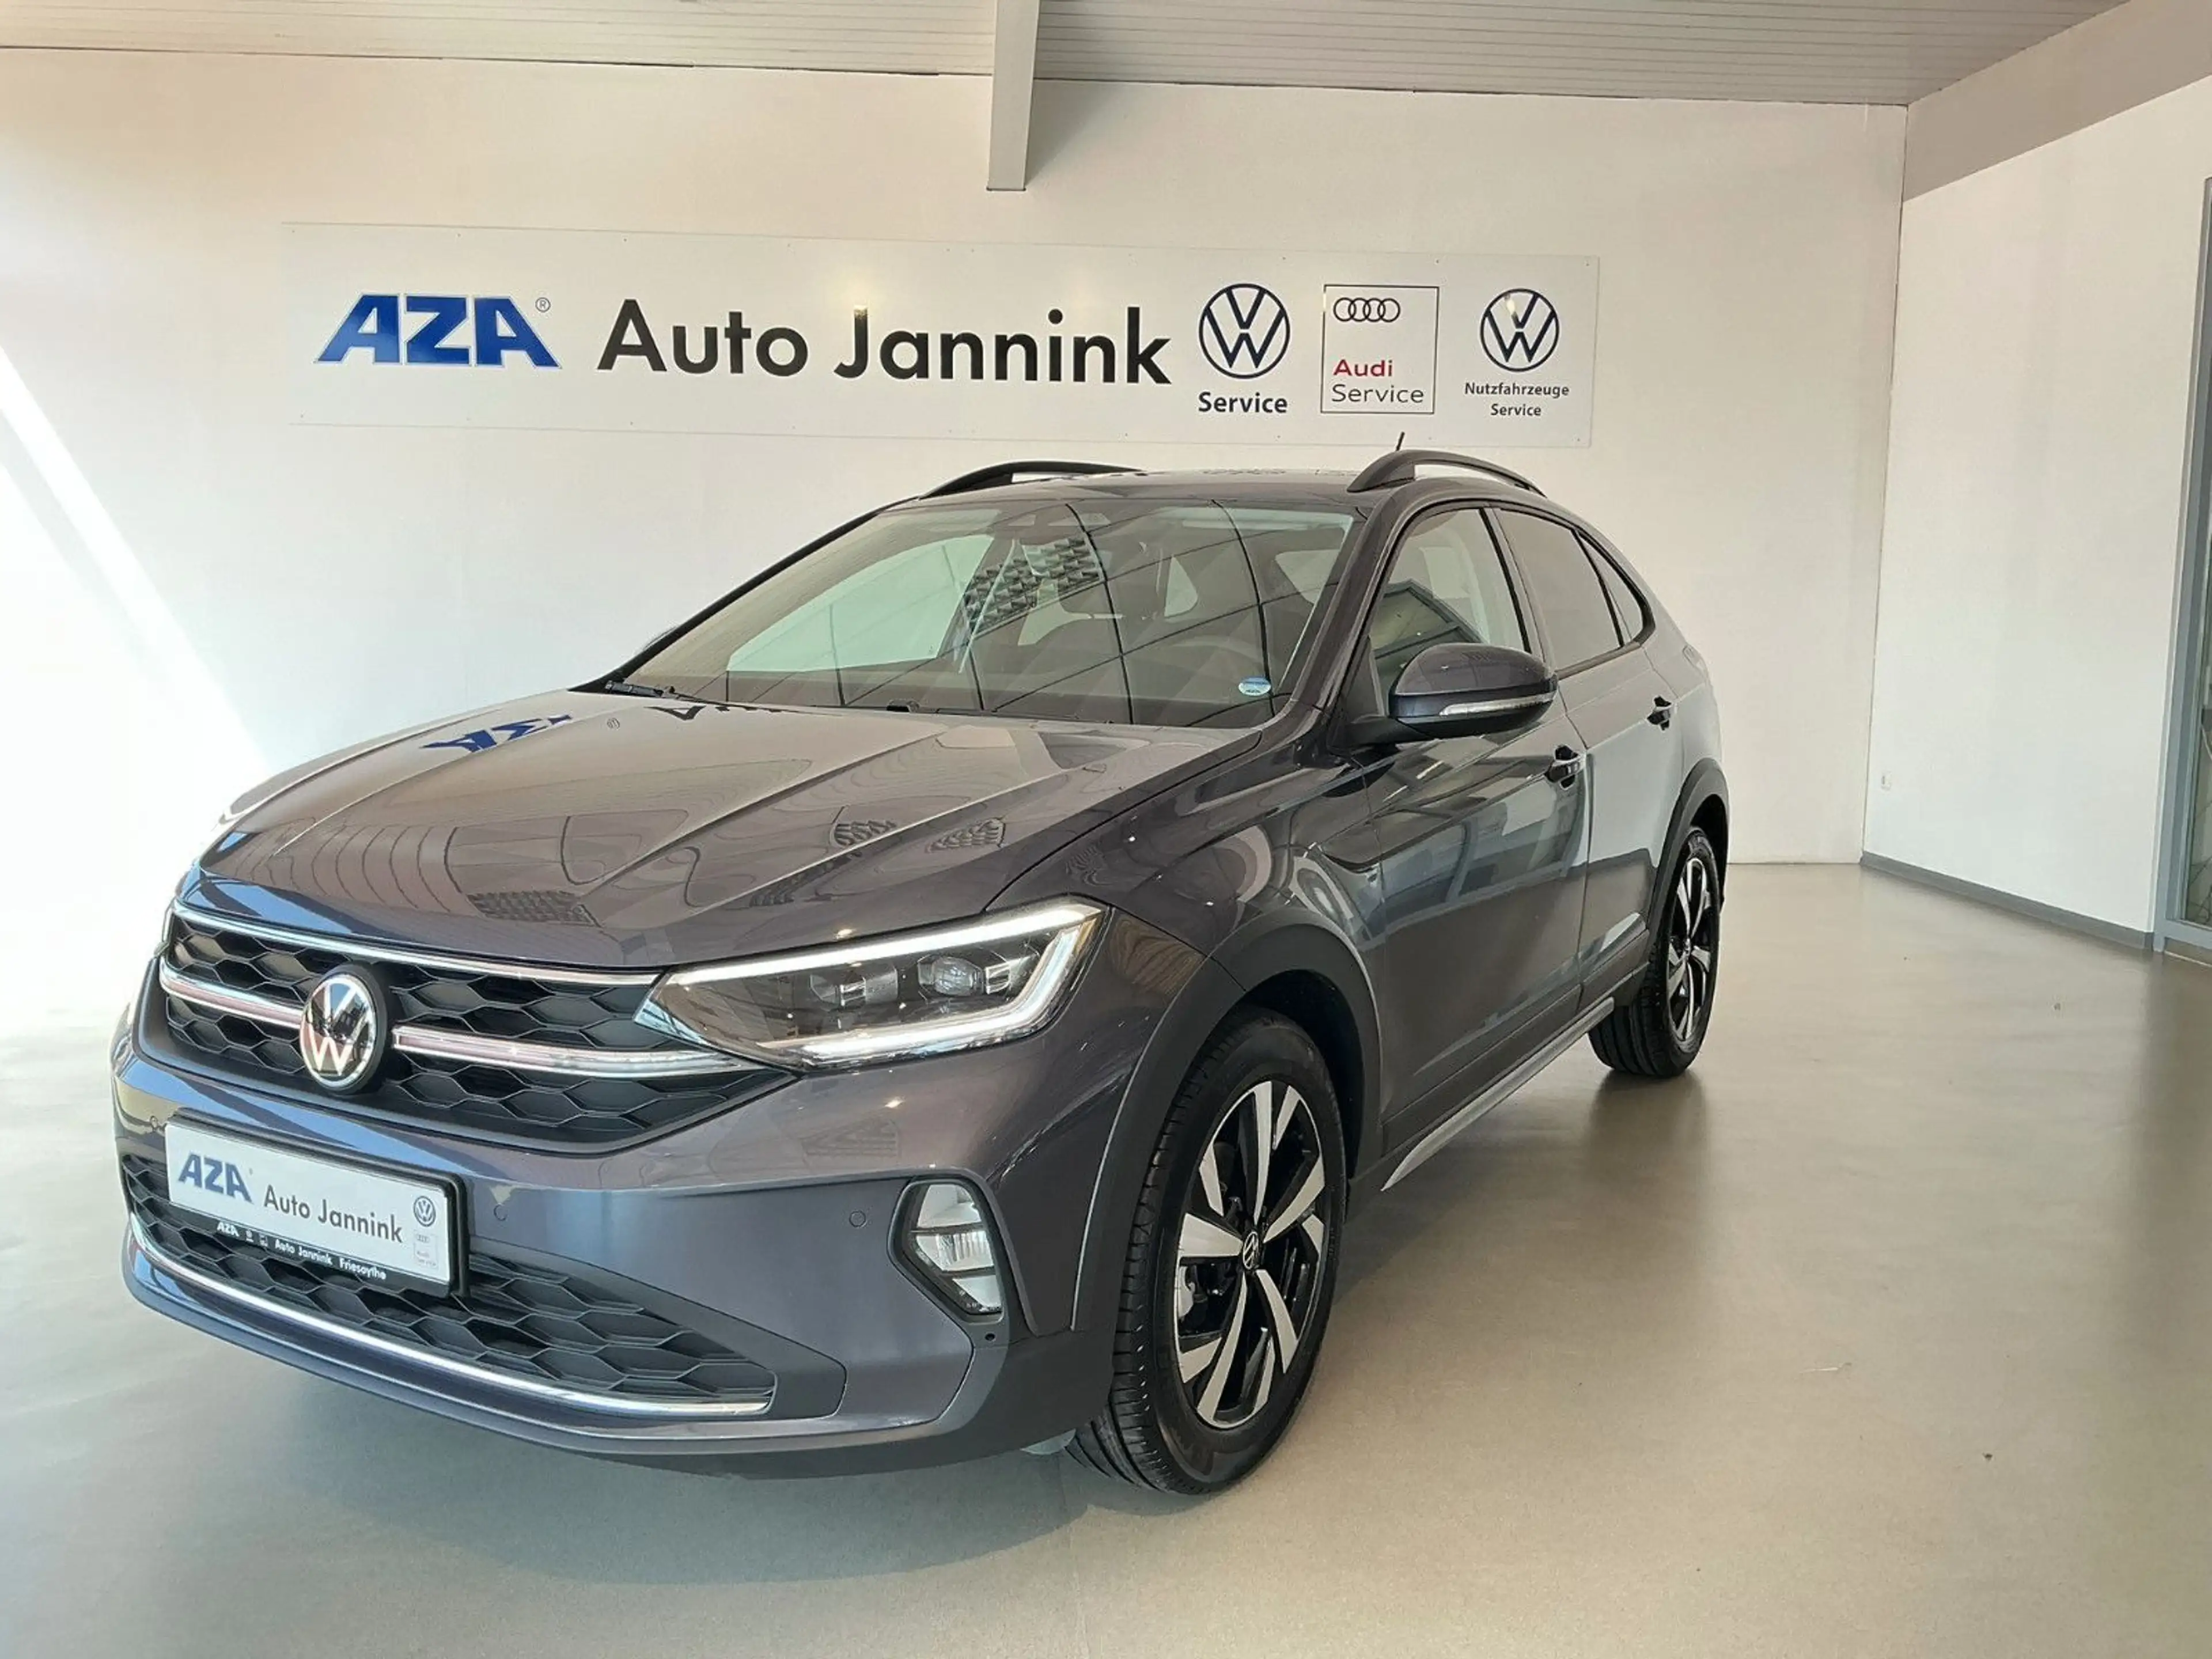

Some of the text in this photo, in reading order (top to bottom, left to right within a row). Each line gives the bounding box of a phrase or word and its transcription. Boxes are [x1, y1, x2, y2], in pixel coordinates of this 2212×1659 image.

[314, 293, 562, 369] AZA
[597, 298, 1172, 384] Auto Jannink
[1199, 283, 1290, 379] VW
[1333, 358, 1393, 377] Audi
[1198, 392, 1288, 413] Service
[1331, 384, 1425, 403] Service
[1465, 382, 1570, 399] Nutzfahrzeuge
[1490, 403, 1542, 416] Service
[178, 1153, 253, 1205] AZA
[263, 1184, 403, 1243] Auto Jannink
[217, 1221, 240, 1237] AZA
[274, 1238, 295, 1255] Auto
[298, 1245, 333, 1266] Jannink
